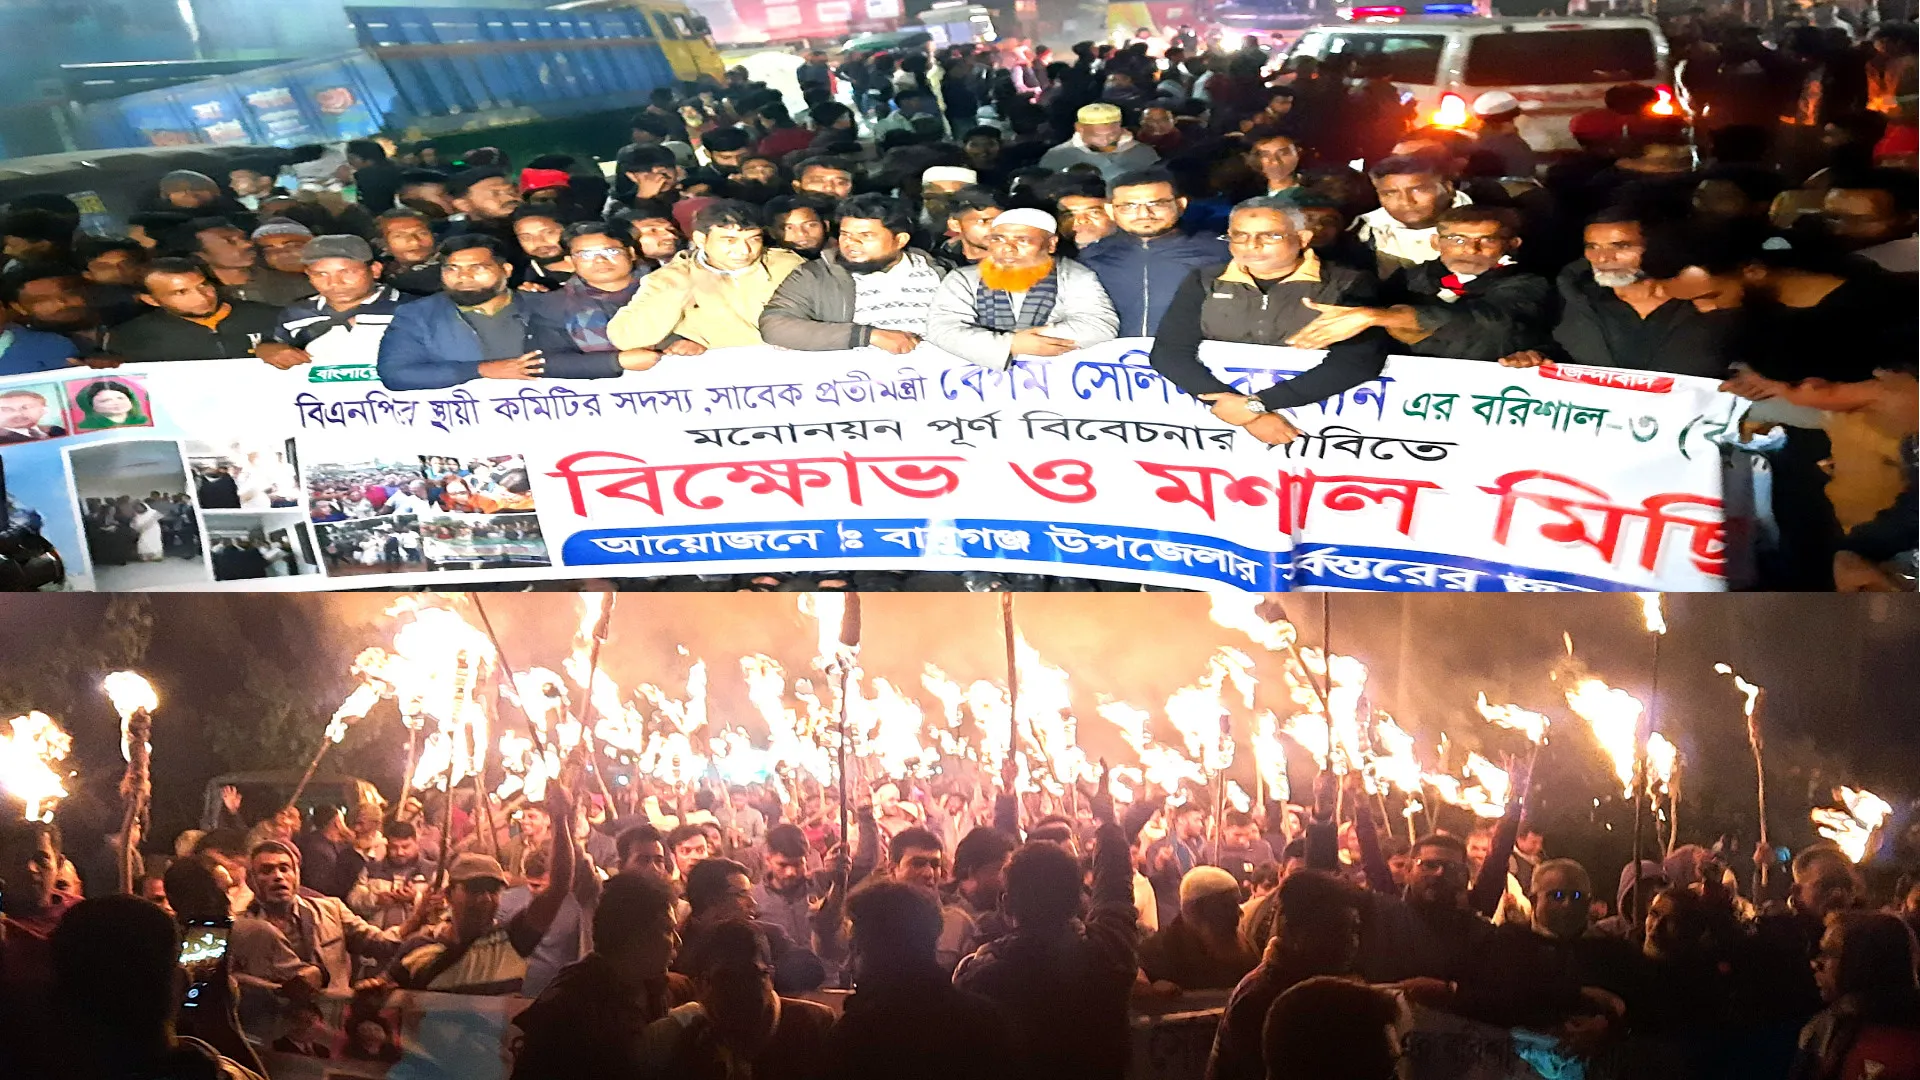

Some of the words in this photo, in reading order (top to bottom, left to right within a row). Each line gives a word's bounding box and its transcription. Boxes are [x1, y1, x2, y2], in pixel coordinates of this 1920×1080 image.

[295, 390, 420, 430] বিএনপির
[488, 387, 601, 422] কমিটির
[610, 389, 694, 415] সদস্য
[1402, 392, 1460, 423] এর
[685, 417, 903, 448] মনোনয়ন
[927, 409, 1002, 449] পূর্ণ
[1018, 410, 1237, 453] বিবেচনার
[545, 451, 968, 517] বিক্ষোভ
[1008, 457, 1099, 504] ও
[1134, 459, 1443, 537] মশাল
[590, 527, 824, 556] আয়োজনে
[1043, 524, 1265, 585] উপজেলার
